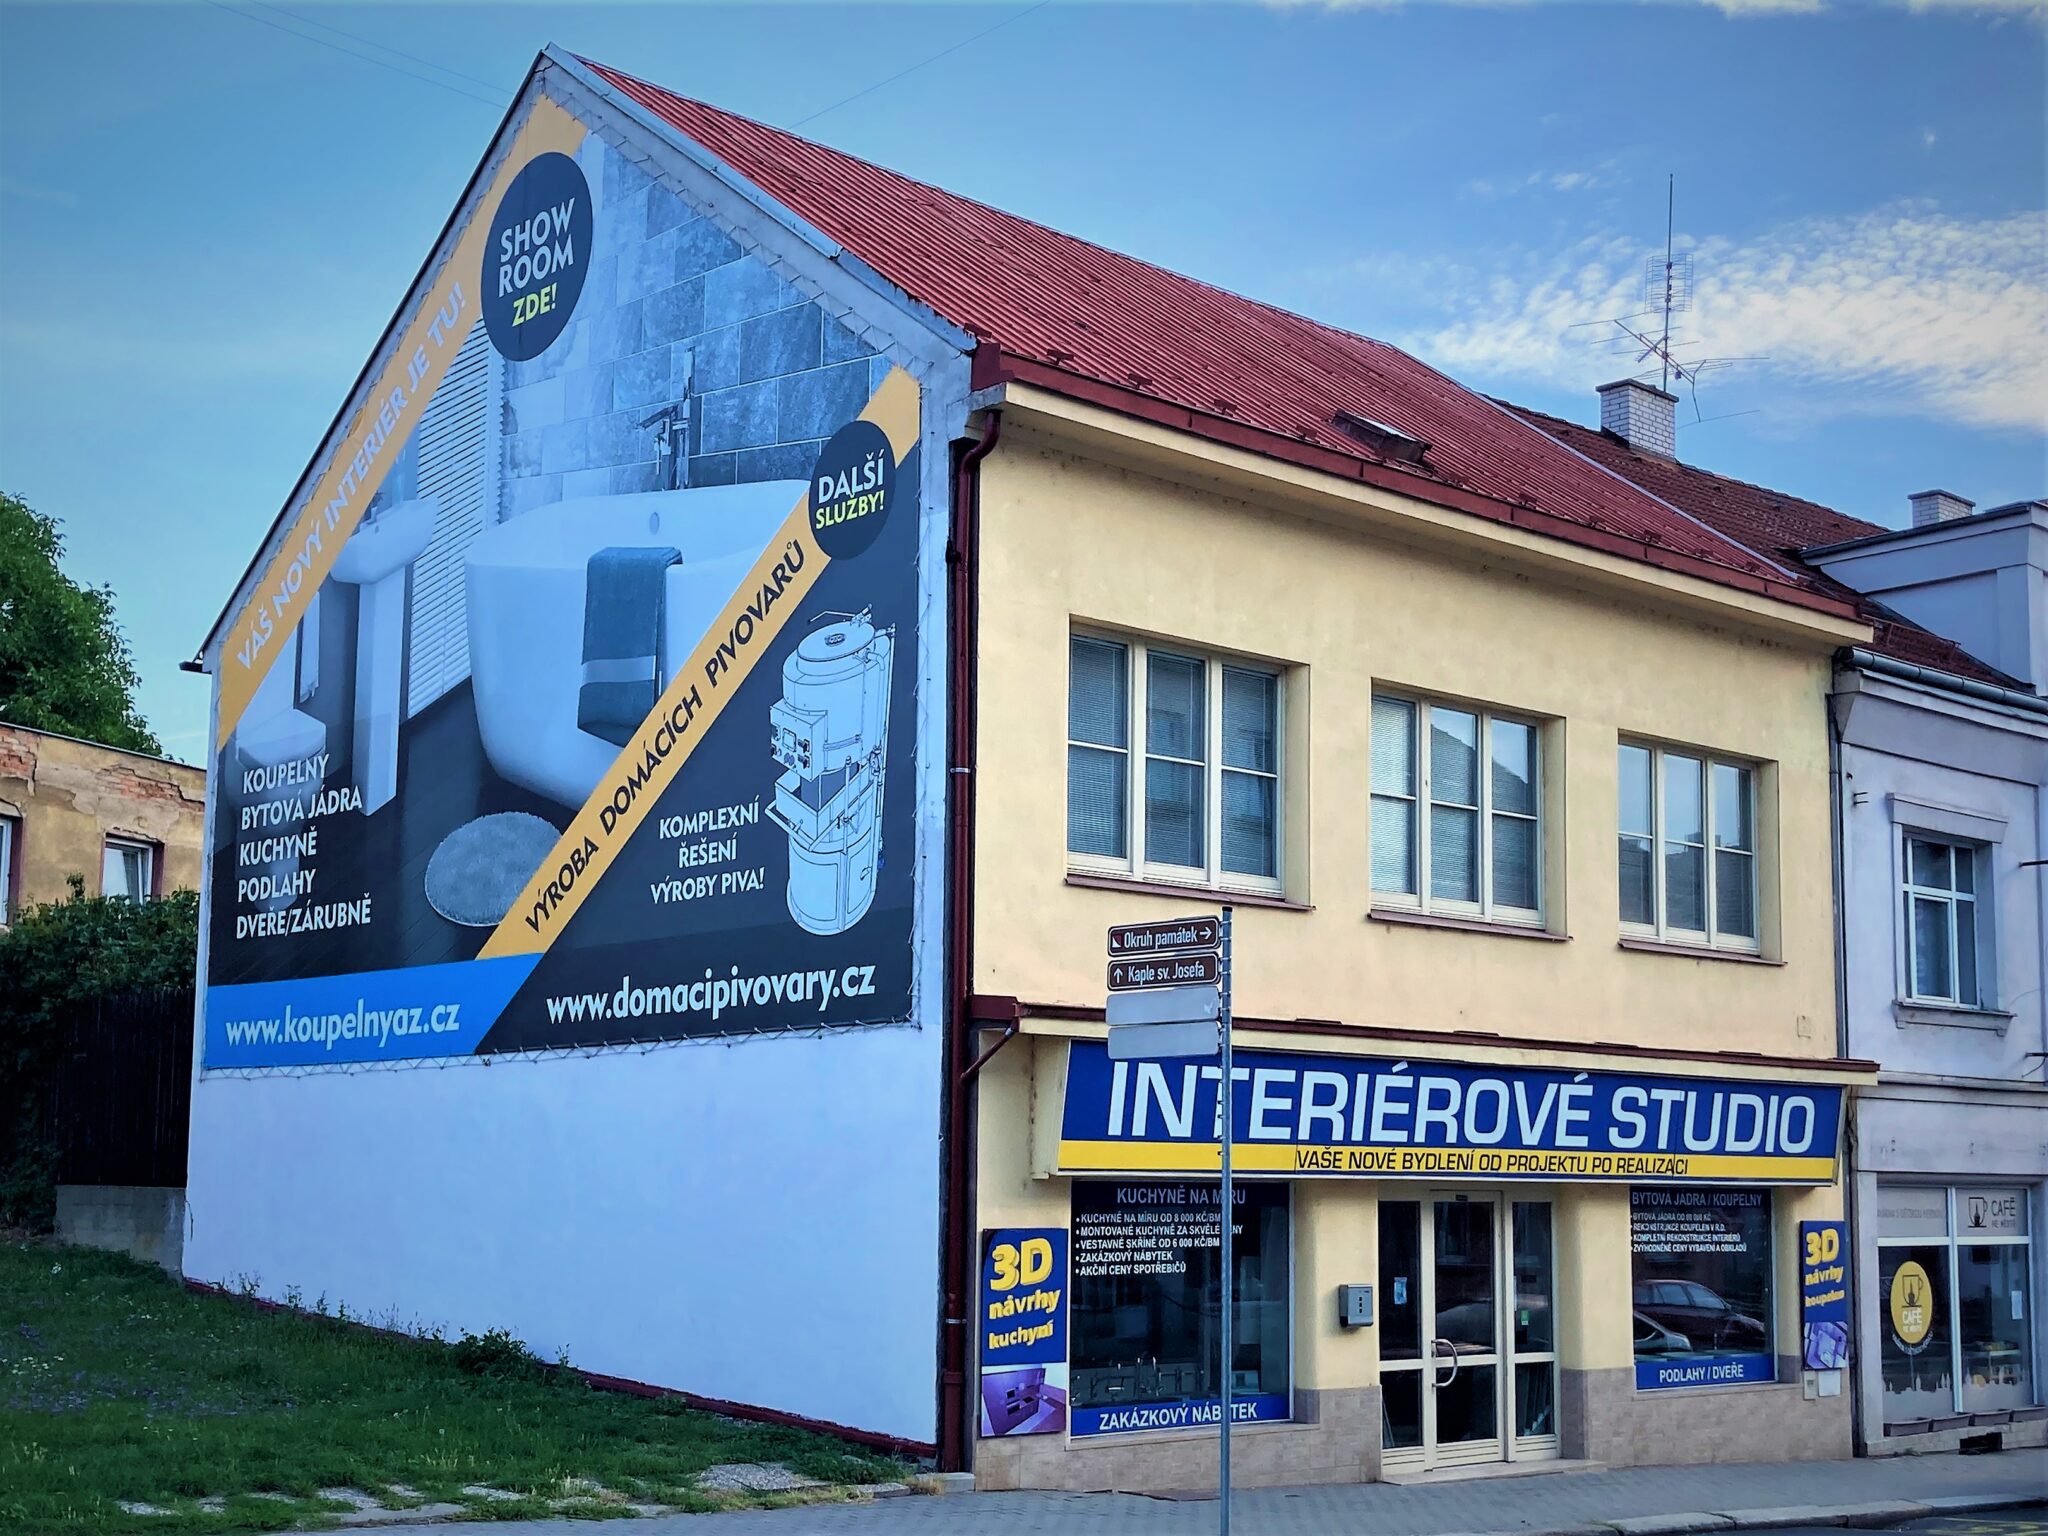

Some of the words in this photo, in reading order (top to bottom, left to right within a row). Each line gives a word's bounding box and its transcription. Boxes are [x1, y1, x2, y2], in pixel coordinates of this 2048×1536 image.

[500, 197, 575, 263] SHOW
[498, 233, 574, 298] ROOM
[512, 282, 557, 327] ZDE!
[237, 605, 273, 671] VÁŠ
[272, 520, 323, 618] NOVÝ
[324, 386, 408, 531] INTERIÉR
[409, 343, 430, 393] JE
[427, 281, 467, 349] TU!
[818, 449, 885, 504] DALŠÍ
[815, 490, 885, 530] SLUŽBY!
[525, 836, 599, 934] VÝROBA
[599, 684, 703, 836] DOMÁCÍCH
[705, 539, 804, 687] PIVOVARŮ
[243, 754, 330, 794] KOUPELNY
[241, 793, 304, 830] BYTOVÁ
[308, 785, 362, 820] JÁDRA
[659, 795, 760, 839] KOMPLEXNÍ
[239, 826, 318, 867] KUCHYNĚ
[678, 832, 737, 868] ŘEŠENÍ
[238, 869, 316, 903] PODLAHY
[650, 875, 715, 904] VÝROBY
[721, 868, 764, 896] PIVA!
[236, 893, 372, 940] DVEŘE/ZÁRUBNĚ
[1124, 930, 1152, 948] Okruh
[1155, 926, 1198, 950] památek
[1128, 964, 1155, 986] Kaple
[1157, 967, 1170, 980] sv.
[1172, 961, 1204, 979] Josefa
[547, 964, 876, 1025] www.domacipivovary.cz
[225, 998, 460, 1050] www.koupelnyaz.cz
[1107, 1058, 1594, 1148] INTERIÉROVÉ
[1608, 1086, 1815, 1155] STUDIO
[1297, 1147, 1343, 1170] VAŠE
[1348, 1148, 1397, 1170] NOVÉ
[1402, 1149, 1477, 1172] BYDLENÍ
[1479, 1153, 1501, 1172] OD
[1507, 1154, 1588, 1173] PROJEKTU
[1591, 1157, 1612, 1173] PO
[1617, 1157, 1689, 1175] REALIZACI
[1117, 1186, 1186, 1204] KUCHYNĚ
[1190, 1189, 1209, 1204] NA
[1212, 1189, 1246, 1204] MRU
[1632, 1190, 1672, 1205] BYTOVÁ
[1674, 1190, 1705, 1206] JÁDRA
[1713, 1193, 1762, 1206] KOUPELNY
[1080, 1224, 1134, 1236] MONTOVANÉ
[1177, 1226, 1188, 1235] ZA
[1189, 1223, 1220, 1235] SKVĚLÉ
[1124, 1213, 1136, 1223] NA
[1137, 1211, 1158, 1222] MÍRU
[1160, 1213, 1172, 1222] OD
[1174, 1213, 1178, 1222] 8
[1181, 1213, 1193, 1222] 000
[1195, 1211, 1221, 1222] KČ/BM
[1080, 1250, 1132, 1263] ZAKÁZKOVÝ
[1133, 1250, 1173, 1261] NÁBYTEK
[1126, 1236, 1156, 1248] SKŘÍNĚ
[1158, 1238, 1170, 1247] OD
[1179, 1238, 1192, 1247] 000
[1194, 1236, 1220, 1247] KČ/BM
[1805, 1228, 1839, 1265] 3D
[990, 1238, 1053, 1291] 3D
[1080, 1263, 1107, 1276] AKČNÍ
[1109, 1264, 1131, 1275] CENY
[1133, 1261, 1186, 1274] SPOTŘEBIČŮ
[1805, 1265, 1844, 1286] návrhy
[989, 1289, 1061, 1319] návrhy
[988, 1319, 1053, 1349] kuchyní
[1659, 1366, 1705, 1383] PODLAHY
[1712, 1361, 1744, 1380] DVEŘE
[1099, 1403, 1189, 1431] ZAKÁZKOVÝ
[1192, 1400, 1257, 1424] NÁBTEK
